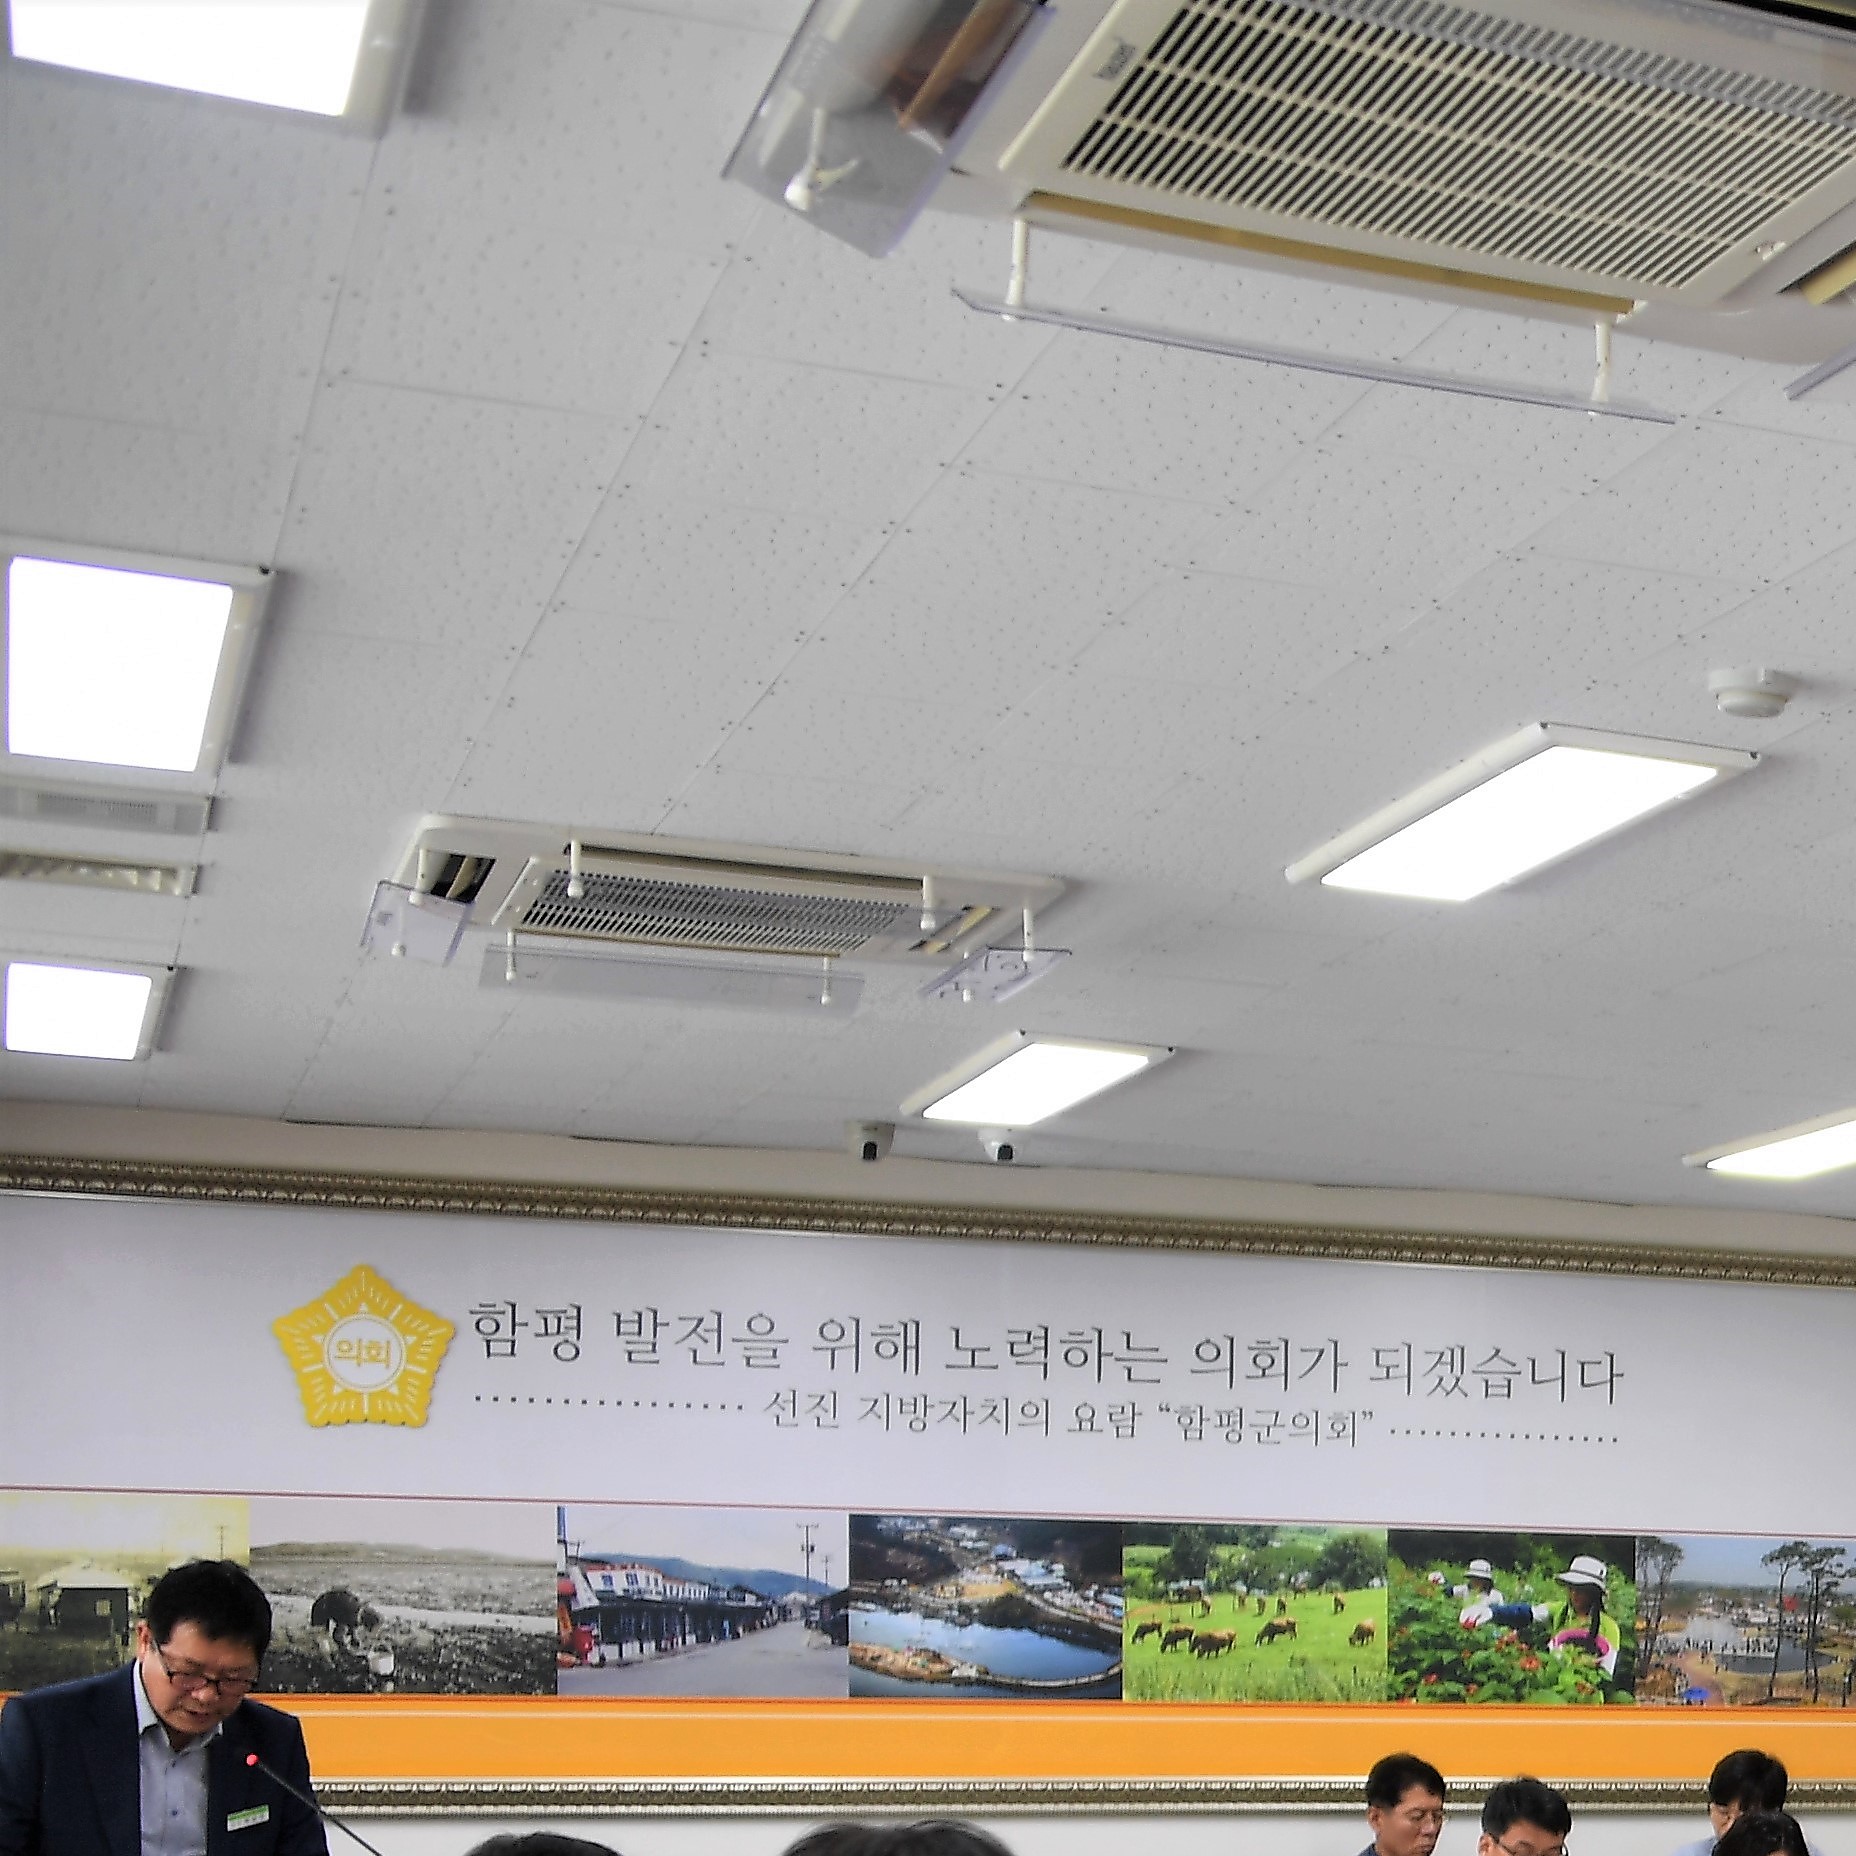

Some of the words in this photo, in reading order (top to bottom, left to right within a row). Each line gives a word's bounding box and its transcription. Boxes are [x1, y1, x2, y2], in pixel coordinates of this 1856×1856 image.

[334, 1337, 391, 1369] 의회
[468, 1299, 583, 1363] 함평
[612, 1304, 790, 1369] 발전을
[811, 1315, 921, 1377] 위해
[944, 1321, 1169, 1385] 노력하는
[1189, 1334, 1349, 1394] 의회가
[1369, 1340, 1625, 1405] 되겠습니다
[762, 1388, 840, 1431] 선진
[857, 1390, 1051, 1438] 지방자치의
[1065, 1400, 1143, 1440] 요람
